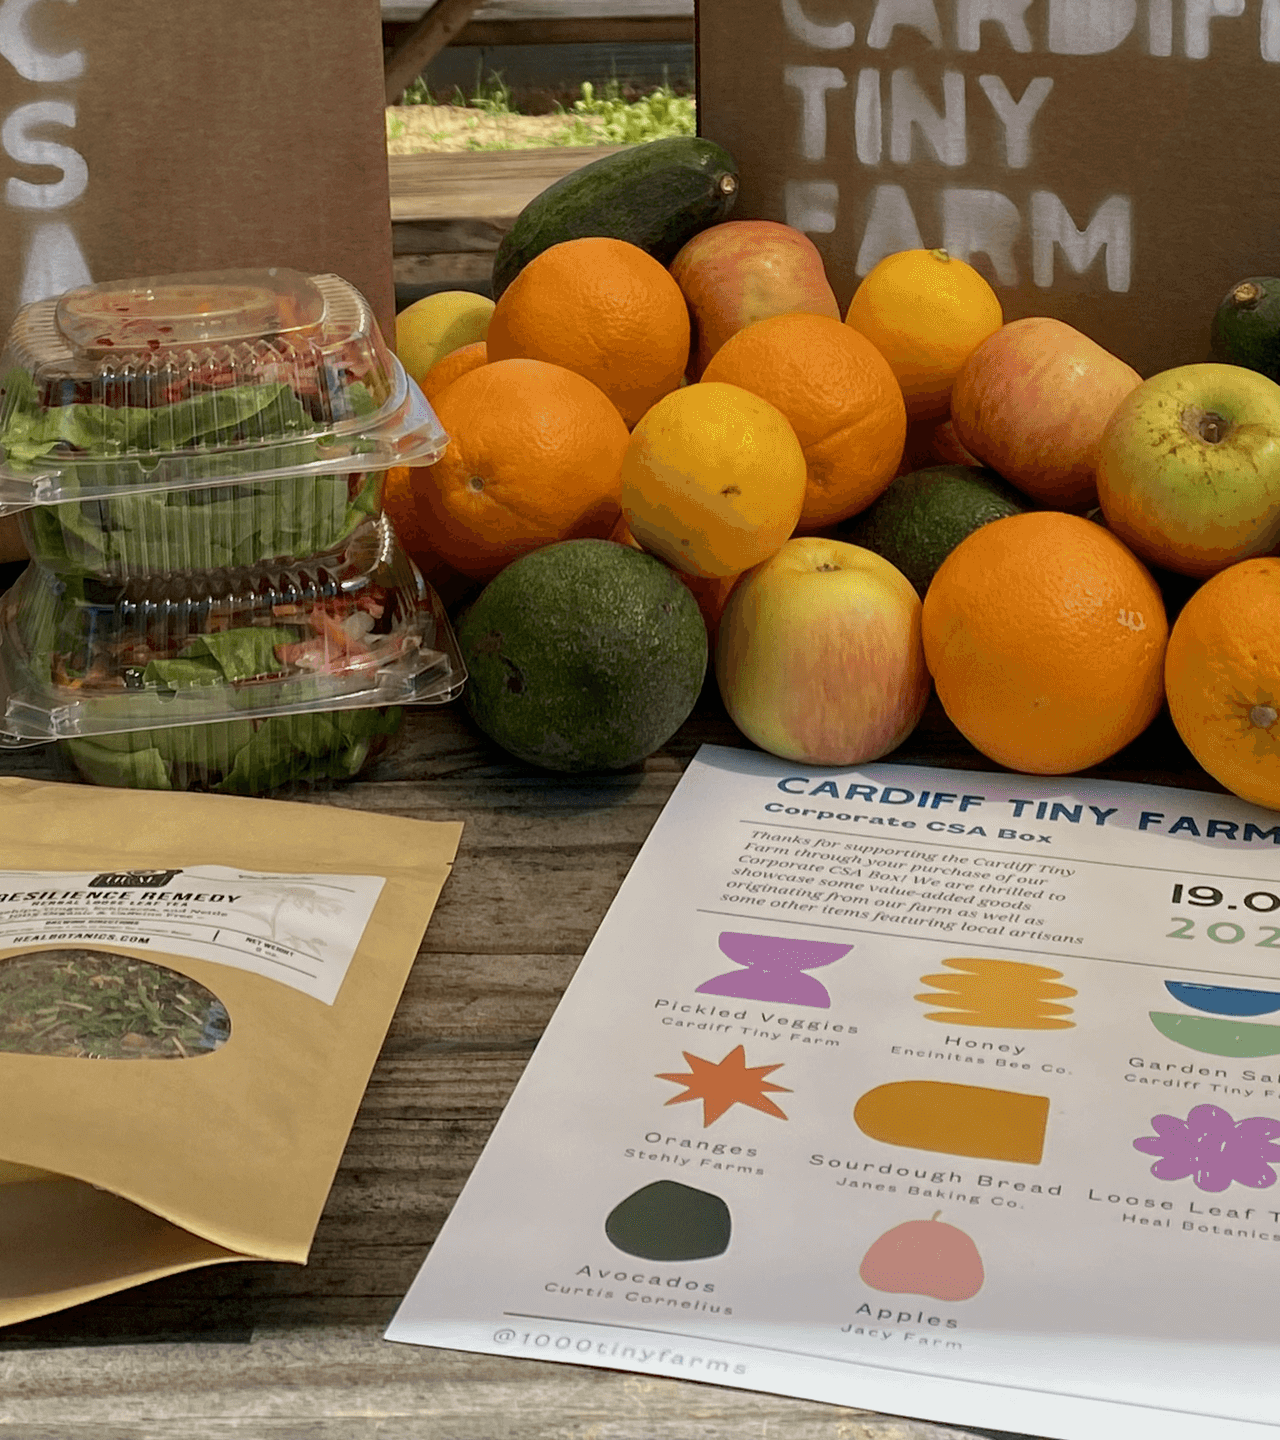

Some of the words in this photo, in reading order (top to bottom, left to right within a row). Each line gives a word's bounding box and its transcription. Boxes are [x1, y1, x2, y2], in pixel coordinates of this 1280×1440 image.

[782, 65, 1054, 169] TINY
[785, 181, 1132, 293] FARM
[777, 777, 986, 813] CARDIFF
[1009, 797, 1119, 827] TINY
[764, 802, 917, 830] Corporate
[926, 820, 988, 838] CSA
[997, 828, 1053, 844] Box
[744, 842, 789, 855] Farm
[794, 849, 862, 865] through
[862, 858, 908, 869] your
[909, 862, 991, 880] purchase
[995, 873, 1016, 884] of
[1016, 876, 1049, 886] our
[751, 830, 811, 846] Thanks
[812, 838, 841, 849] for
[844, 842, 939, 862] supporting
[941, 854, 969, 865] the
[973, 857, 1036, 873] Cardiff
[1038, 864, 1076, 878] Tiny
[731, 867, 815, 884] showcase
[818, 878, 865, 891] some
[869, 885, 976, 905] value-added
[976, 899, 1032, 910] goods
[738, 854, 825, 872] Corporate
[828, 865, 862, 877] CSA
[868, 870, 908, 883] Box!
[913, 875, 941, 887] We
[944, 881, 975, 891] are
[978, 883, 1044, 900] thrilled
[1048, 892, 1066, 902] to
[140, 891, 242, 904] REMEDY
[726, 880, 825, 901] originating
[823, 891, 869, 905] from
[874, 899, 907, 909] our
[907, 902, 953, 915] farm
[957, 909, 978, 918] as
[983, 912, 1021, 924] well
[1024, 917, 1045, 926] as
[719, 893, 767, 907] some
[770, 900, 819, 912] other
[822, 905, 870, 919] items
[870, 910, 958, 932] featuring
[961, 921, 1006, 935] local
[1009, 930, 1085, 945] artisans
[13, 932, 151, 945] HEALBOTANICS.COM
[654, 998, 747, 1020] Pickled
[761, 1012, 860, 1035] Veggies
[661, 1016, 732, 1033] Cardiff
[741, 1026, 782, 1042] Tiny
[790, 1034, 841, 1047] Farm
[891, 1045, 986, 1065] Encinitas
[996, 1058, 1031, 1071] Bee
[1041, 1064, 1073, 1075] Co.
[944, 1035, 1027, 1056] Honey
[1128, 1056, 1228, 1078] Garden
[1124, 1073, 1201, 1091] Cardiff
[1209, 1083, 1255, 1098] Tiny
[645, 1131, 758, 1157] Oranges
[624, 1148, 691, 1167] Stehly
[700, 1159, 765, 1176] Farms
[809, 1154, 963, 1184] Sourdough
[977, 1174, 1062, 1196] Bread
[836, 1177, 897, 1194] Janes
[907, 1186, 981, 1208] Baking
[991, 1195, 1025, 1210] Co.
[1088, 1189, 1174, 1212] Loose
[1189, 1201, 1256, 1221] Leaf
[1122, 1213, 1171, 1229] Heal
[575, 1263, 718, 1294] Avocados
[544, 1281, 615, 1301] Curtis
[625, 1290, 735, 1316] Cornelius
[855, 1302, 960, 1330] Apples
[492, 1326, 749, 1377] @1000tinyfarms
[840, 1322, 893, 1344] Jacy
[903, 1331, 965, 1351] Farm
